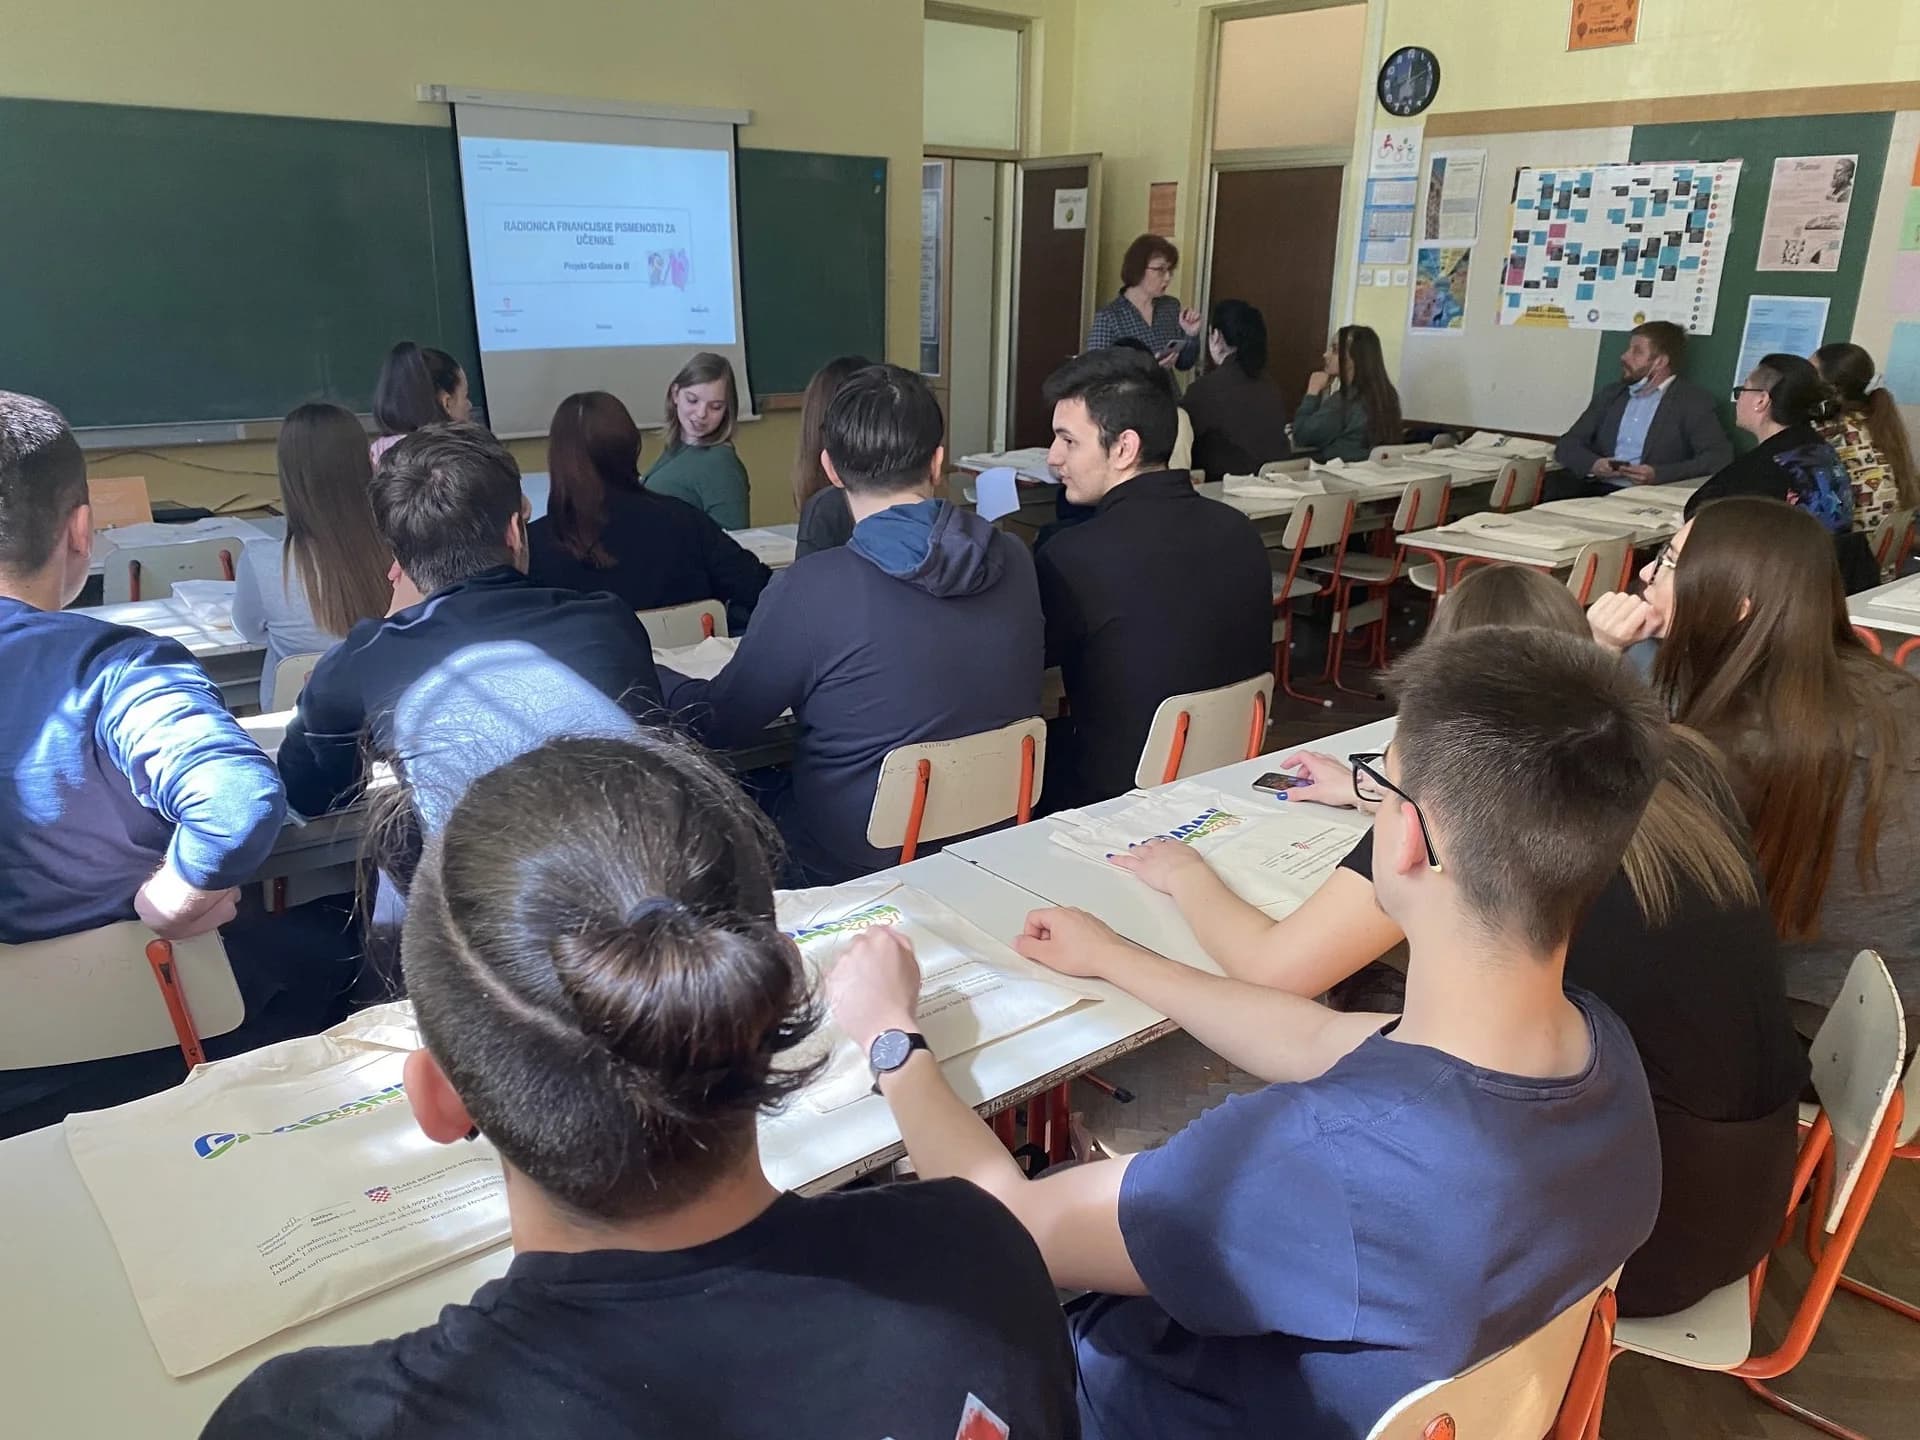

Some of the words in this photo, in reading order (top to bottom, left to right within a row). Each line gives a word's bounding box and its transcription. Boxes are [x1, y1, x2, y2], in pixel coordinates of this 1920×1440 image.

[503, 220, 556, 231] RADIONICA
[557, 221, 614, 232] FINANCIJSKE
[615, 222, 664, 233] PISMENOSTI
[665, 223, 676, 233] ZA
[576, 234, 615, 246] UČENIKE
[268, 1251, 297, 1271] Projekt
[278, 1267, 307, 1287] Projekt
